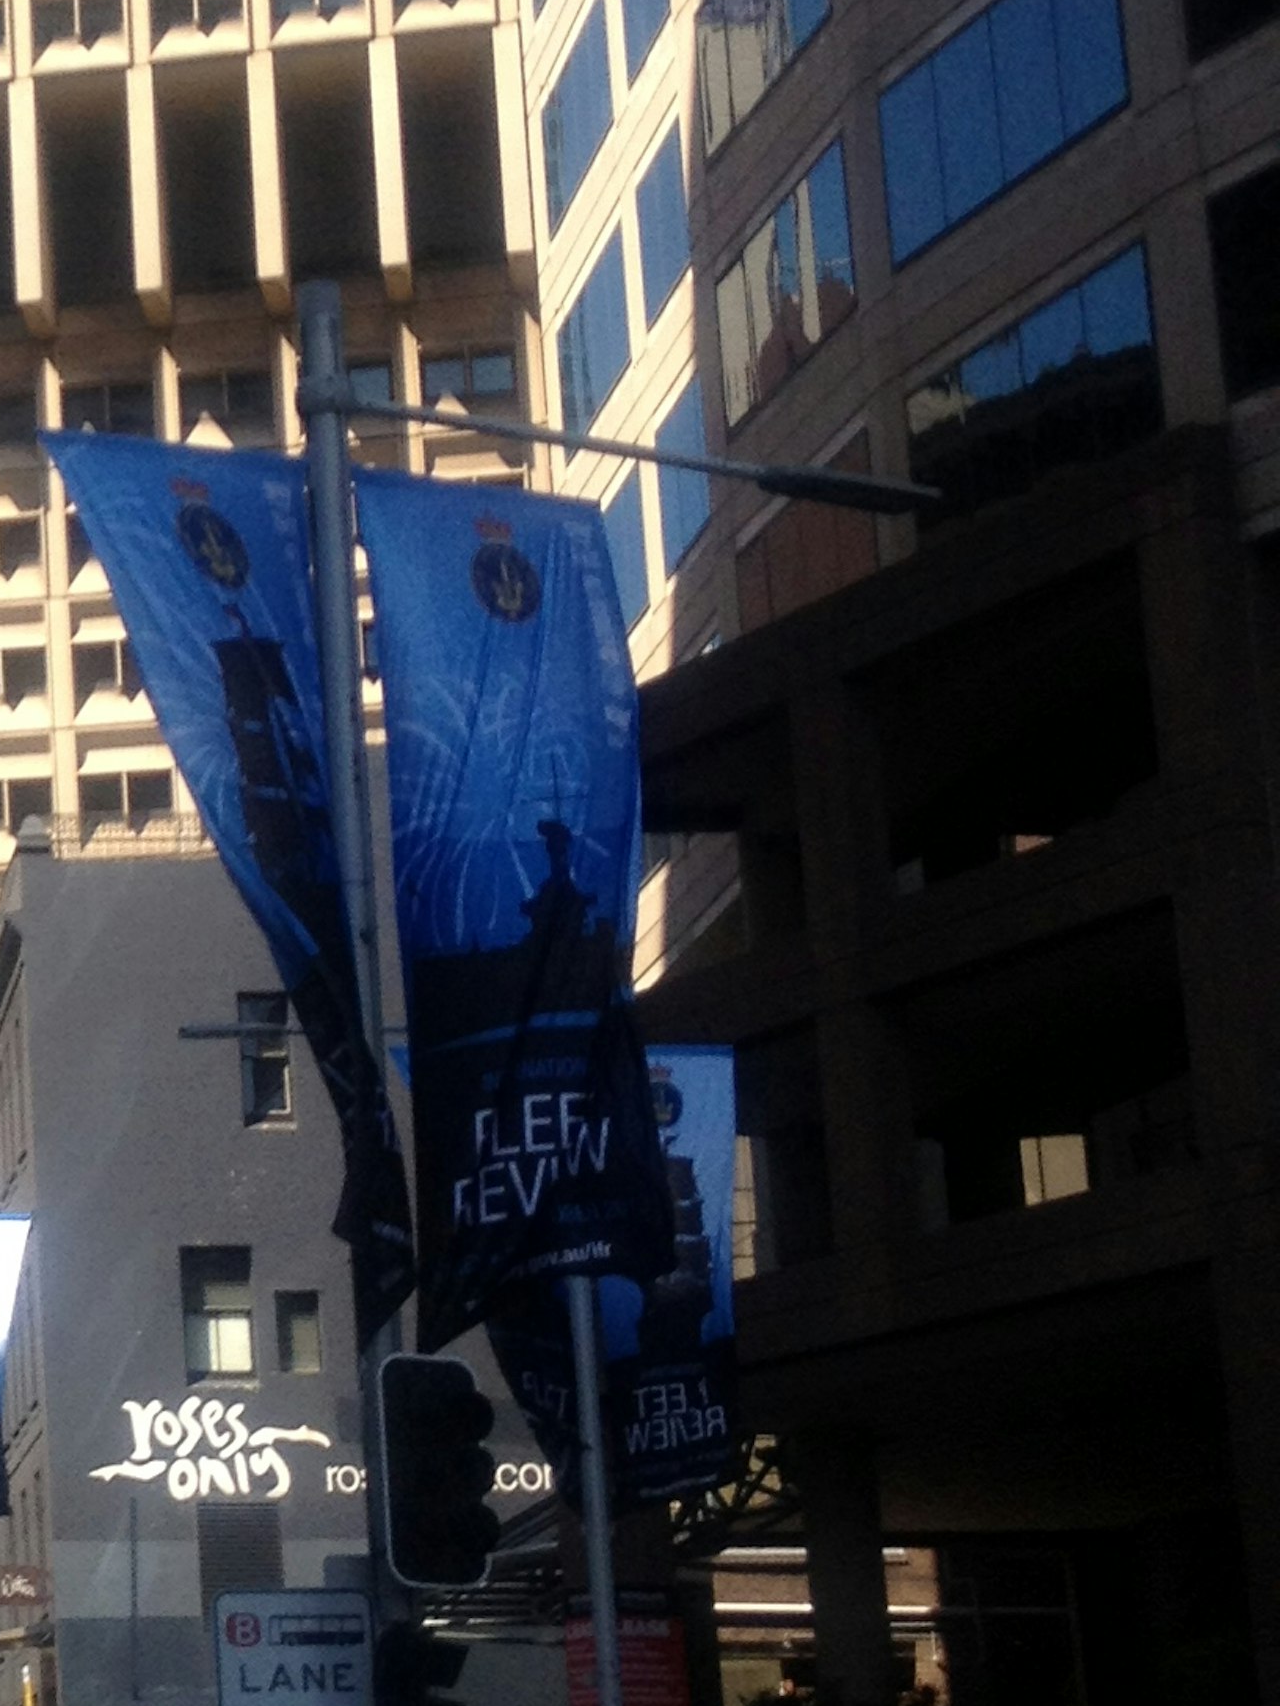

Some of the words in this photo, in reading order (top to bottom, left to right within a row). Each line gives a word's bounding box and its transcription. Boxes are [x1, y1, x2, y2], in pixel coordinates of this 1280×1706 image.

[474, 1091, 592, 1158] FLEE
[453, 1117, 611, 1231] REVIW
[123, 1395, 250, 1460] roses
[164, 1444, 292, 1500] only
[240, 1662, 357, 1694] LANE
